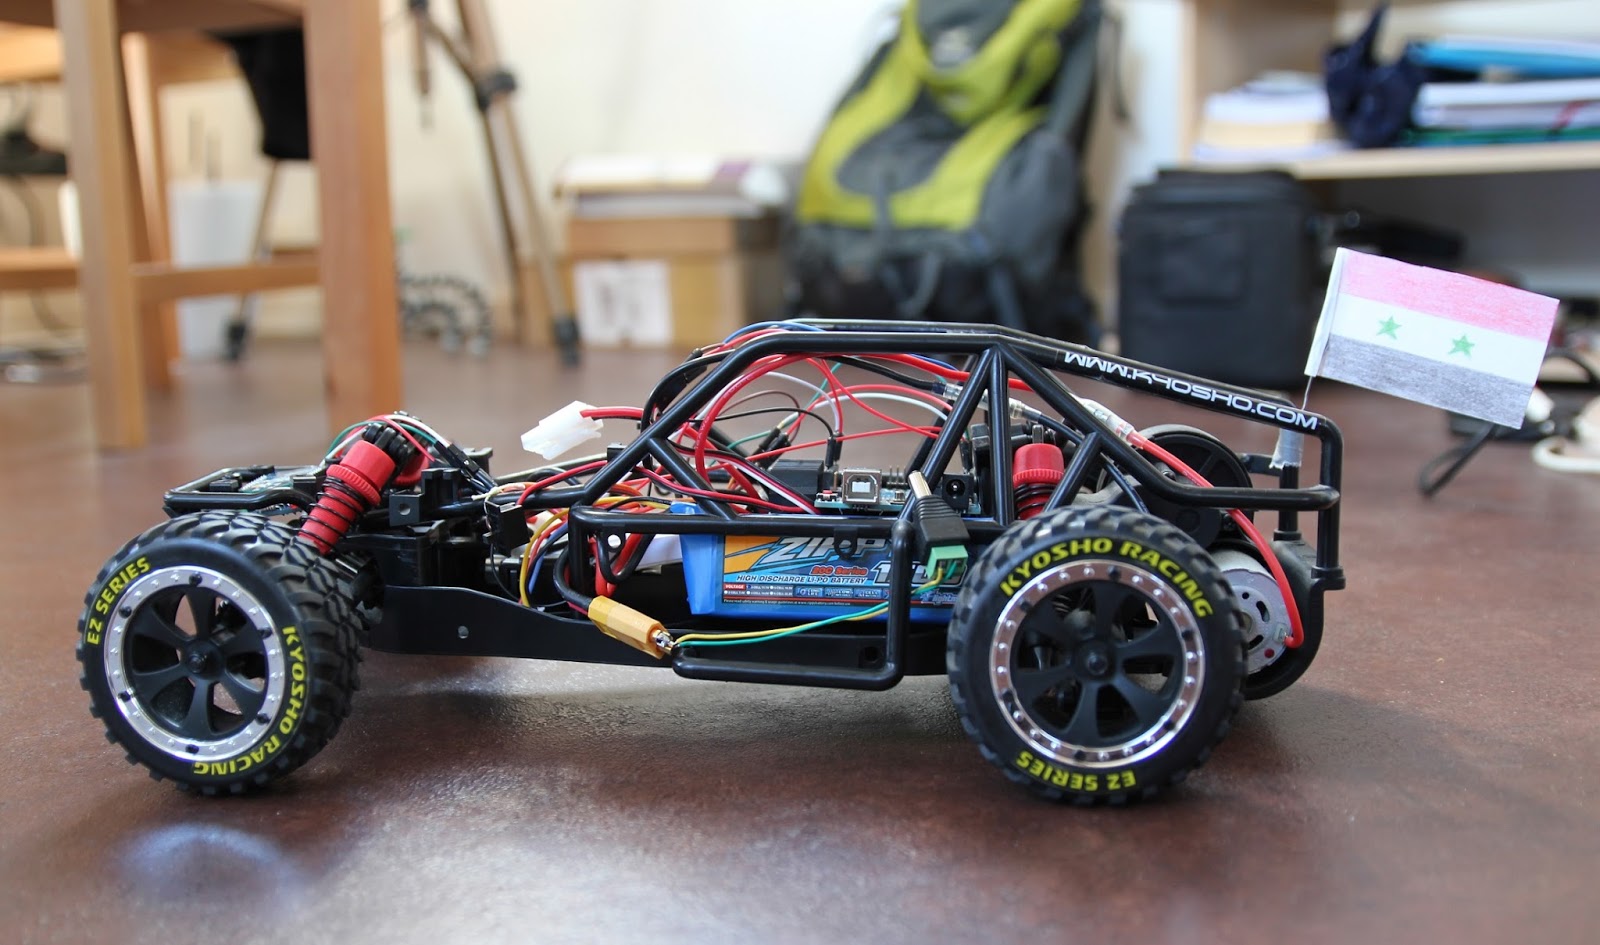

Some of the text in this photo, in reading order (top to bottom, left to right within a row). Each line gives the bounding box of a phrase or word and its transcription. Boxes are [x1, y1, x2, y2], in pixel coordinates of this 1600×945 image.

[1063, 351, 1318, 430] WWW.KYOSHO.COM
[87, 556, 151, 645] EZ SERIES
[736, 574, 758, 582] HIGH
[758, 575, 805, 583] DISCHARGE
[831, 577, 867, 585] BATTERY
[1000, 537, 1213, 618] KYOSHO RACING
[193, 626, 305, 776] KYOSHO RACING
[1015, 751, 1136, 791] EZ SERIES
